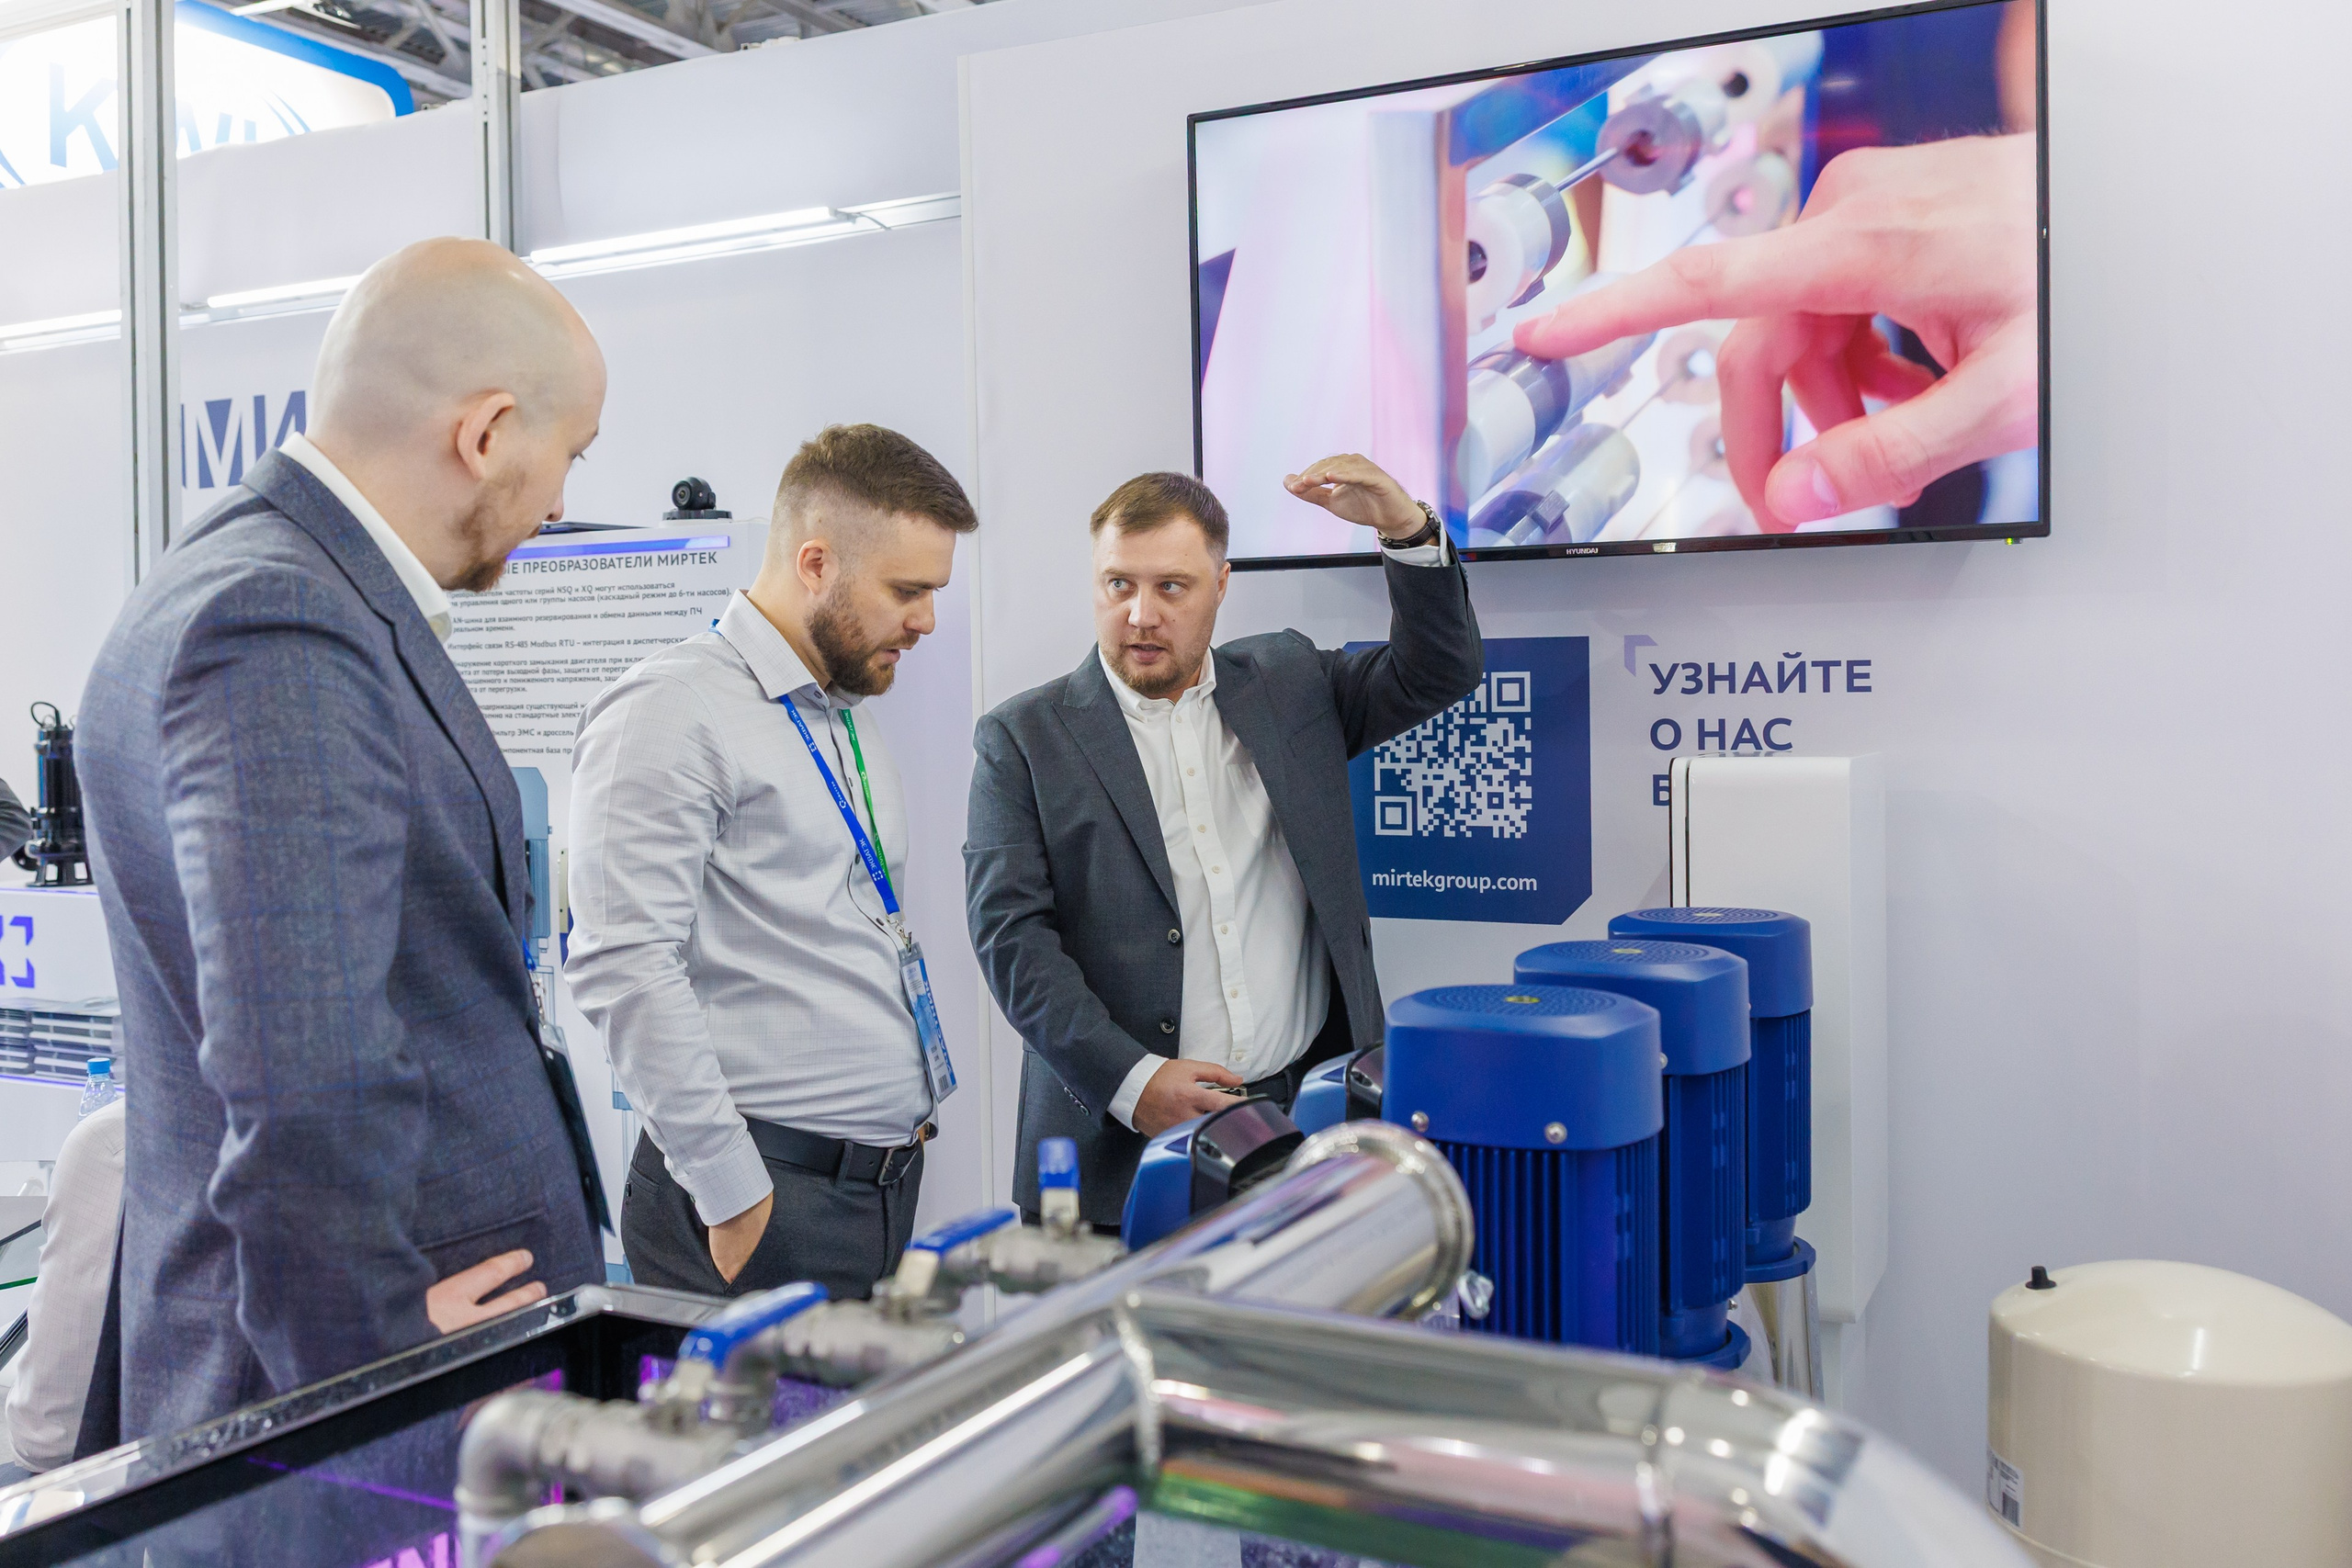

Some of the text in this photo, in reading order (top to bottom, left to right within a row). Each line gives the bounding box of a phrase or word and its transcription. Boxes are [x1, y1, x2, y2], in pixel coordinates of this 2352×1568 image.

[523, 555, 653, 574] ПРЕОБРАЗОВАТЕЛИ
[658, 551, 718, 567] МИРТЕК
[557, 586, 572, 595] NSQ
[581, 584, 594, 594] XQ
[594, 585, 616, 593] могут
[617, 582, 675, 591] использоваться
[460, 599, 499, 608] управления
[597, 592, 639, 603] (каскадный
[696, 587, 732, 597] насосов).
[535, 613, 592, 622] резервирования
[628, 610, 662, 618] данными
[664, 609, 688, 617] между
[690, 607, 703, 615] ПЧ
[504, 640, 528, 649] RS-485
[582, 638, 625, 648] интеграция
[493, 660, 527, 668] короткого
[506, 667, 539, 675] выходной
[541, 667, 561, 675] фазы,
[564, 666, 590, 674] защита
[556, 675, 603, 683] напряжения,
[1648, 651, 1872, 695] УЗНАЙТЕ
[488, 686, 527, 694] перегрузки.
[526, 702, 578, 711] существующей
[791, 709, 810, 742] ЭКВАТЭК
[1650, 717, 1793, 751] О НАС
[546, 746, 560, 754] база
[859, 838, 877, 871] ЭКВАТЭК
[1372, 868, 1538, 894] mirtekgroup.com
